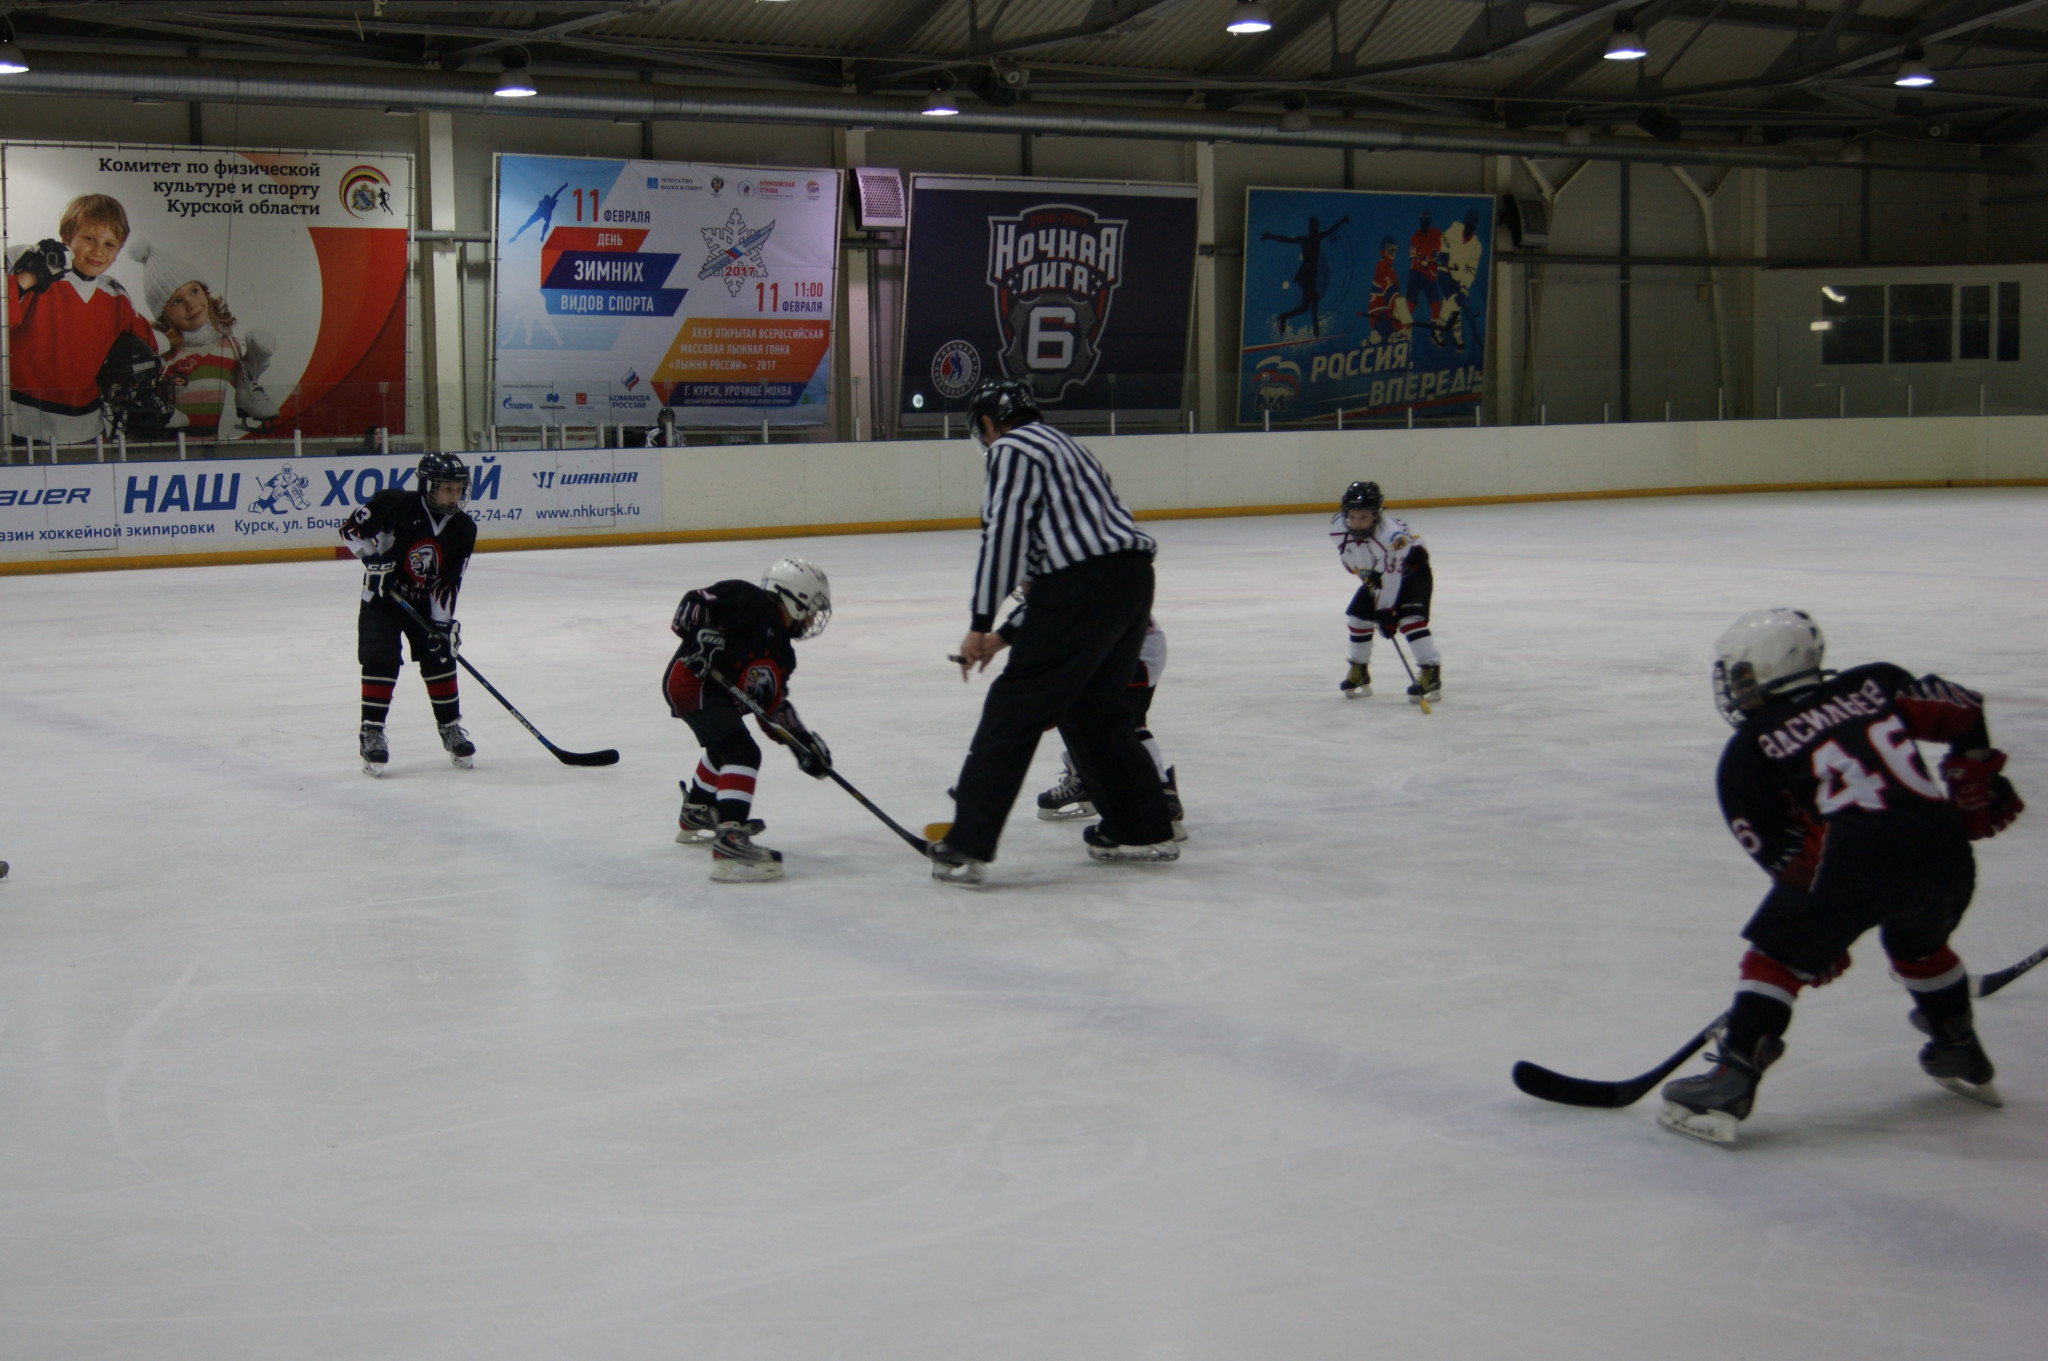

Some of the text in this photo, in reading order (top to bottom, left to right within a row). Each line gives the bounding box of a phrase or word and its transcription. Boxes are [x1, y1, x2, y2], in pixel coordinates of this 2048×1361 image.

[99, 157, 321, 178] Комитет по физической
[152, 179, 320, 200] культуре и спорту
[167, 198, 321, 218] Курской области
[572, 188, 650, 224] 11 ФЕВРАЛЯ
[597, 233, 623, 247] ДЕНЬ
[995, 224, 1119, 283] НОЧНАЯ
[574, 260, 644, 283] ЗИМНИХ
[725, 266, 755, 277] 2017
[1021, 262, 1089, 296] ЛИГА
[756, 282, 779, 313] 11
[794, 282, 823, 297] 11:00
[561, 296, 655, 313] ВИДОВ СПОРТА
[782, 301, 823, 313] ФЕВРАЛЯ
[715, 328, 756, 339] ОТКРЫТАЯ
[759, 327, 824, 340] ВСЕРОССИЙСКАЯ
[1027, 307, 1076, 369] 6
[680, 343, 791, 355] МАССОВАЯ ЛЫЖНАЯ ГОНКА
[669, 359, 708, 370] «ЛЫЖНЯ
[709, 360, 747, 371] РОССИИ»
[756, 360, 776, 371] 2017
[1310, 343, 1414, 383] РОССИЯ,
[684, 386, 793, 397] Г. КУРСК, УРОЧИЩЕ МОКВА
[1368, 365, 1475, 407] ВПЕРЕД!
[608, 394, 650, 402] КОМАНДА
[612, 401, 647, 409] РОССИИ
[123, 456, 502, 514] НАШ ХОКЙ
[560, 471, 639, 486] WARRIOR
[536, 502, 640, 520] www.nhkursk.ru
[39, 525, 121, 541] хоккейной
[126, 523, 215, 538] экипировки
[235, 519, 279, 535] Курск,
[283, 520, 303, 534] ул.
[1810, 713, 1944, 815] 46
